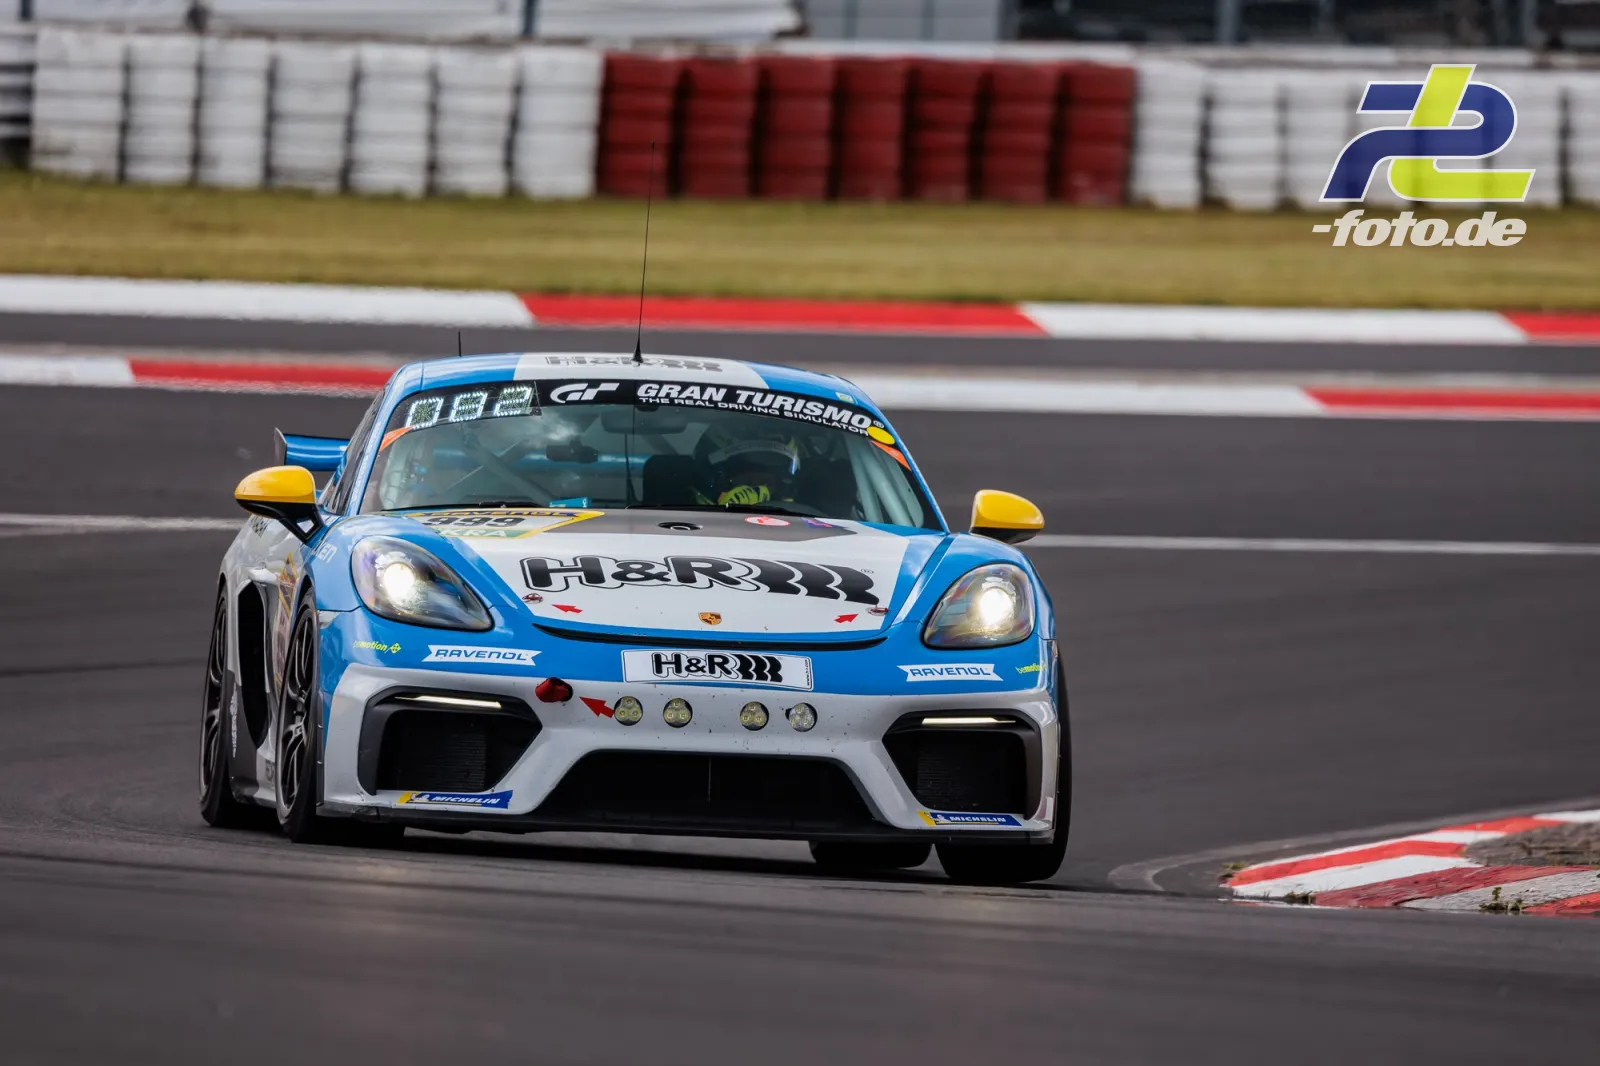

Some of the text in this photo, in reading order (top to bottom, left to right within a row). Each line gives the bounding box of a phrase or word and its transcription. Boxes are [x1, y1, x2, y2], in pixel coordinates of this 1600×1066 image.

[405, 386, 533, 430] 082
[636, 383, 872, 429] GRAN TURISMO
[674, 398, 715, 407] REAL
[718, 402, 780, 415] DRIVING
[783, 409, 869, 437] SIMULATOR
[422, 517, 526, 528] 999
[519, 555, 761, 593] H&R
[434, 648, 528, 661] RAVENOL
[651, 652, 740, 679] H&R
[909, 667, 992, 677] RAVENOL
[431, 796, 501, 805] MICHELIN
[949, 815, 1007, 823] MICHELIN
